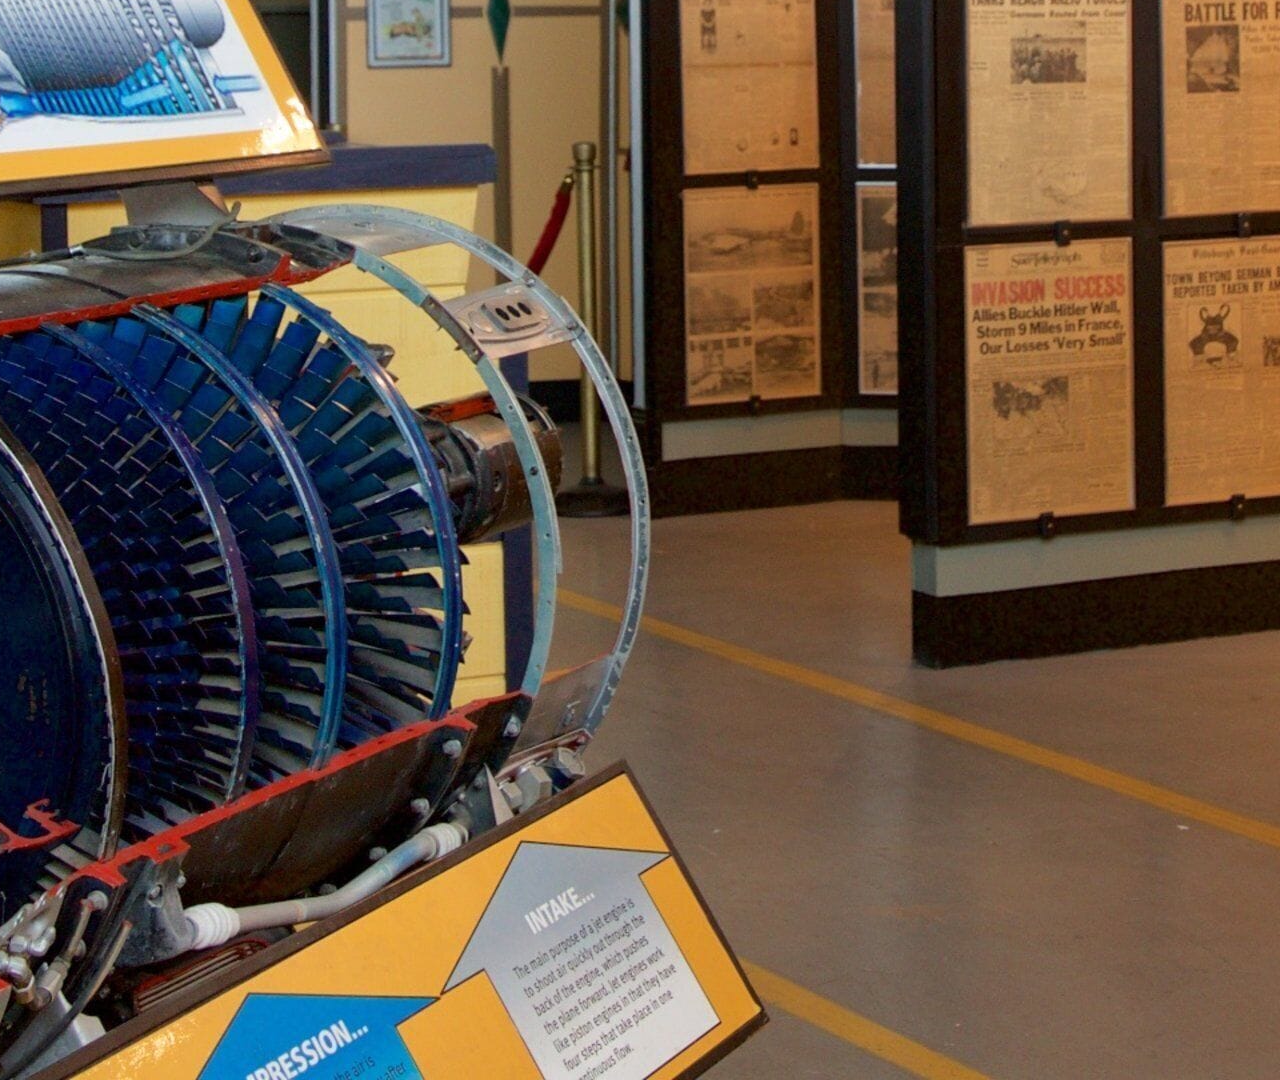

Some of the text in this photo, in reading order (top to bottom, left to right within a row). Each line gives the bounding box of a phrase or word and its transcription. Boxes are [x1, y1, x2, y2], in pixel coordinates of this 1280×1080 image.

[1184, 2, 1236, 22] BATTLE
[1242, 1, 1268, 20] FOR
[972, 273, 1125, 307] INVASION SUCCESS
[973, 309, 1006, 322] Allies
[1009, 306, 1051, 319] Buckle
[1054, 304, 1087, 317] Hitler
[977, 324, 1015, 338] Storm
[1018, 323, 1026, 336] 9
[1029, 322, 1062, 336] Miles
[1065, 320, 1075, 333] in
[980, 342, 1002, 355] Our
[1006, 339, 1050, 354] Losses
[524, 886, 595, 935] INTAKE...
[530, 932, 580, 969] main purpose
[567, 924, 633, 973] quickly through
[619, 960, 648, 983] engines
[648, 946, 665, 965] work
[569, 963, 677, 1045] piston engines have
[581, 1040, 603, 1061] steps
